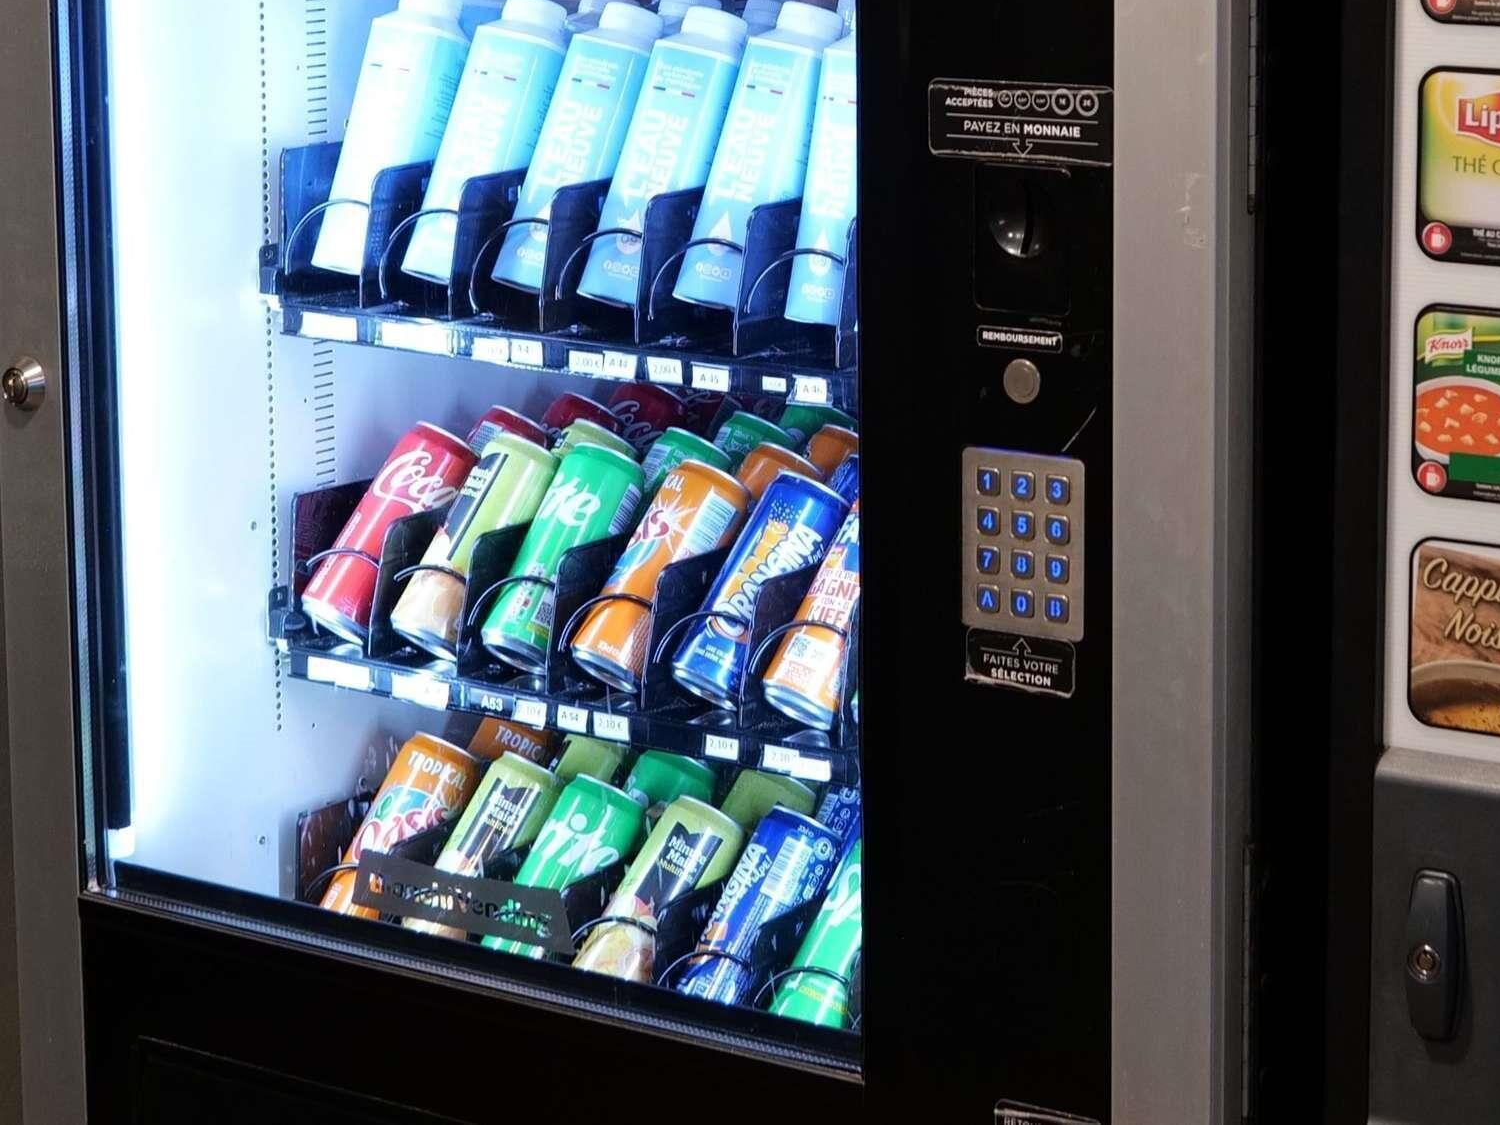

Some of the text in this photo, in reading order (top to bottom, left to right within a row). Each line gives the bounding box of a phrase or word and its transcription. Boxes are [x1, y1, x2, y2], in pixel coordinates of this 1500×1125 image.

[964, 120, 1081, 137] PAYEZ EN MONNAIE
[1453, 155, 1487, 174] THÉ
[983, 331, 1057, 346] REMBOURSEMENT
[1429, 338, 1469, 352] Knorr
[1017, 478, 1027, 493] 2
[1052, 482, 1062, 498] 3
[983, 513, 1061, 537] 4 5 6
[983, 552, 1061, 576] 7 8 9
[1016, 596, 1027, 612] 0
[1051, 601, 1061, 617] B
[983, 653, 1058, 674] FAITES VOTRE
[991, 666, 1051, 687] SÉLECTION
